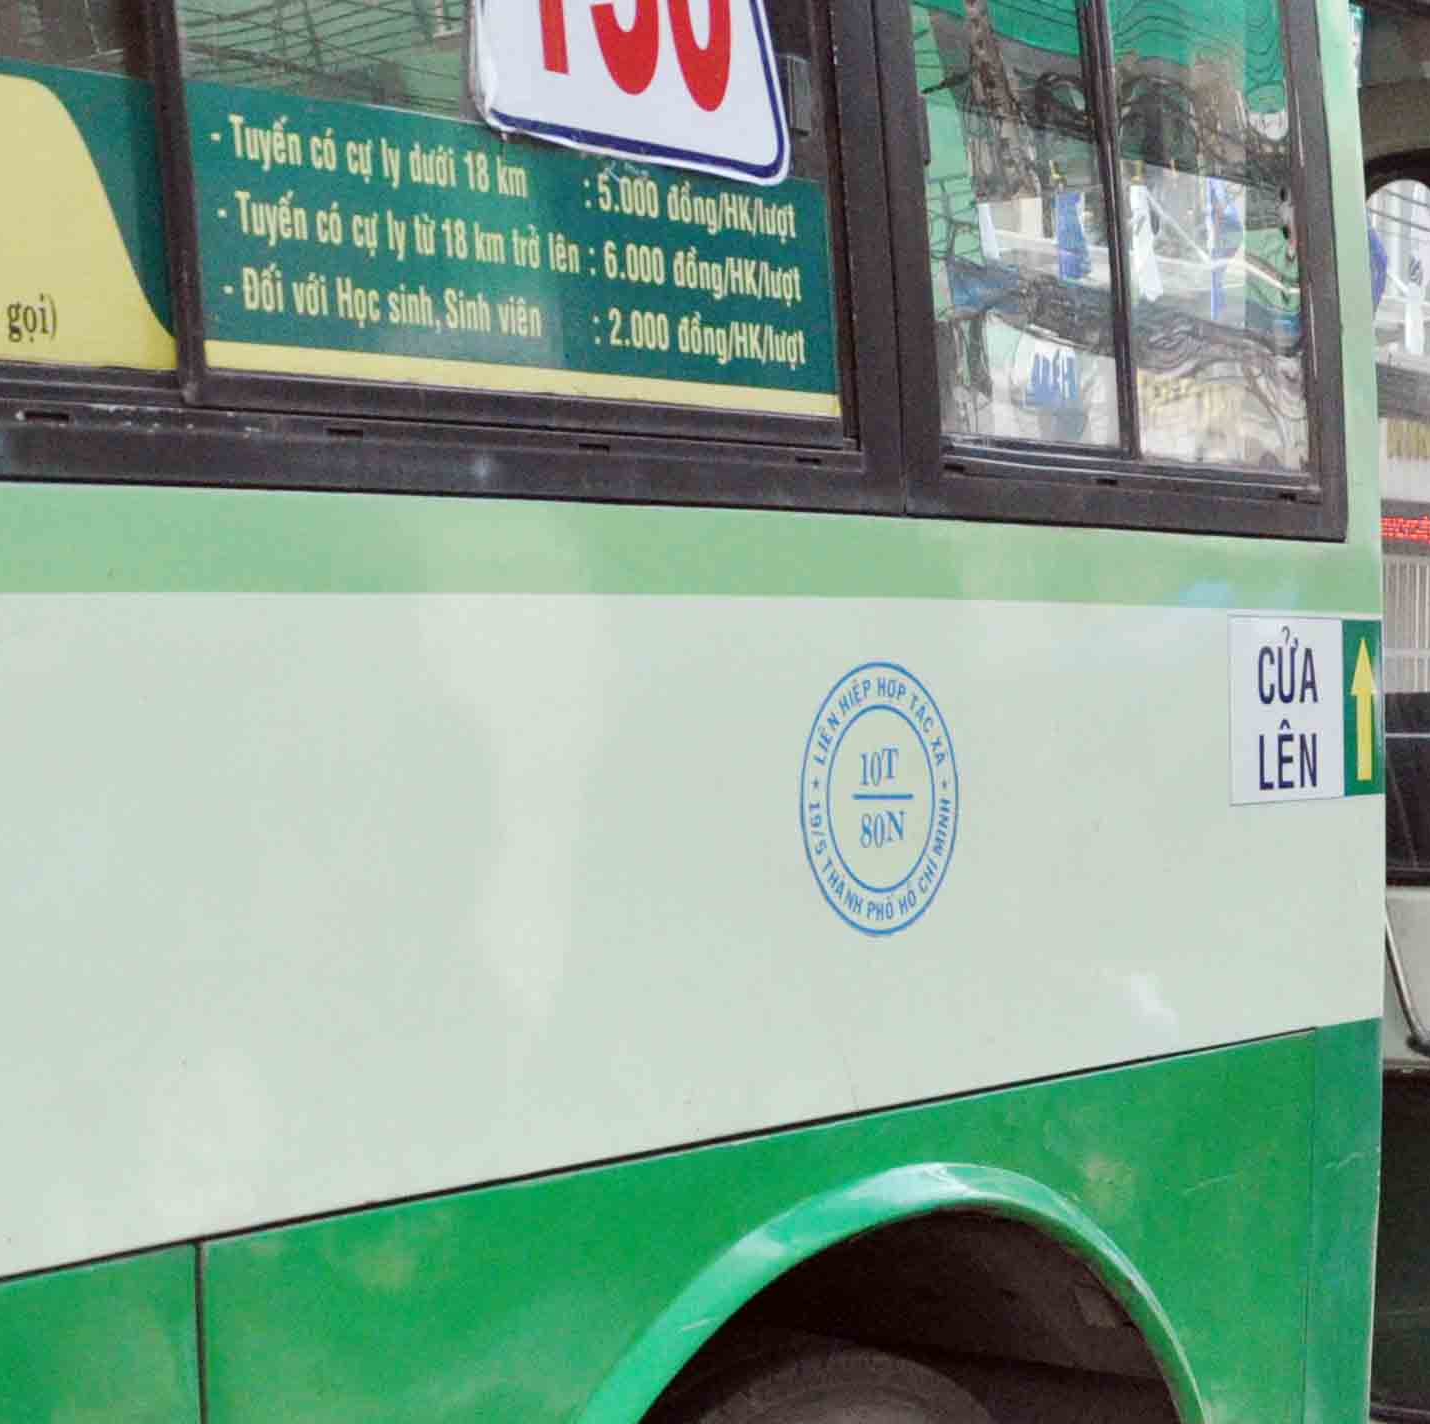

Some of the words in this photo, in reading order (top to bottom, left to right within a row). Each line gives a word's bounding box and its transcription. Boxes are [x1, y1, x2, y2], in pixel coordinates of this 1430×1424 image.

[229, 113, 302, 172] Tuyến
[310, 127, 337, 171] có
[346, 138, 372, 184] cự
[380, 138, 400, 189] ly
[409, 141, 457, 188] dưới
[464, 150, 490, 193] 18
[497, 155, 529, 199] km
[598, 173, 659, 219] 5.000
[235, 190, 308, 247] Tuyến
[316, 202, 342, 246] có
[352, 211, 378, 258] cự
[387, 210, 406, 261] ly
[414, 212, 436, 256] từ
[442, 218, 467, 260] 18
[474, 221, 506, 265] km
[512, 223, 541, 269] trở
[548, 232, 580, 273] lên
[603, 240, 665, 286] 6.000
[7, 292, 58, 343] gọi)
[242, 263, 284, 314] Đối
[292, 271, 329, 317] với
[335, 276, 380, 328] Học
[388, 283, 442, 334] sinh,
[444, 287, 491, 333] Sinh
[497, 295, 542, 338] viên
[608, 307, 670, 352] 2.000
[1258, 625, 1319, 705] CỬA
[1259, 718, 1317, 791] LÊN
